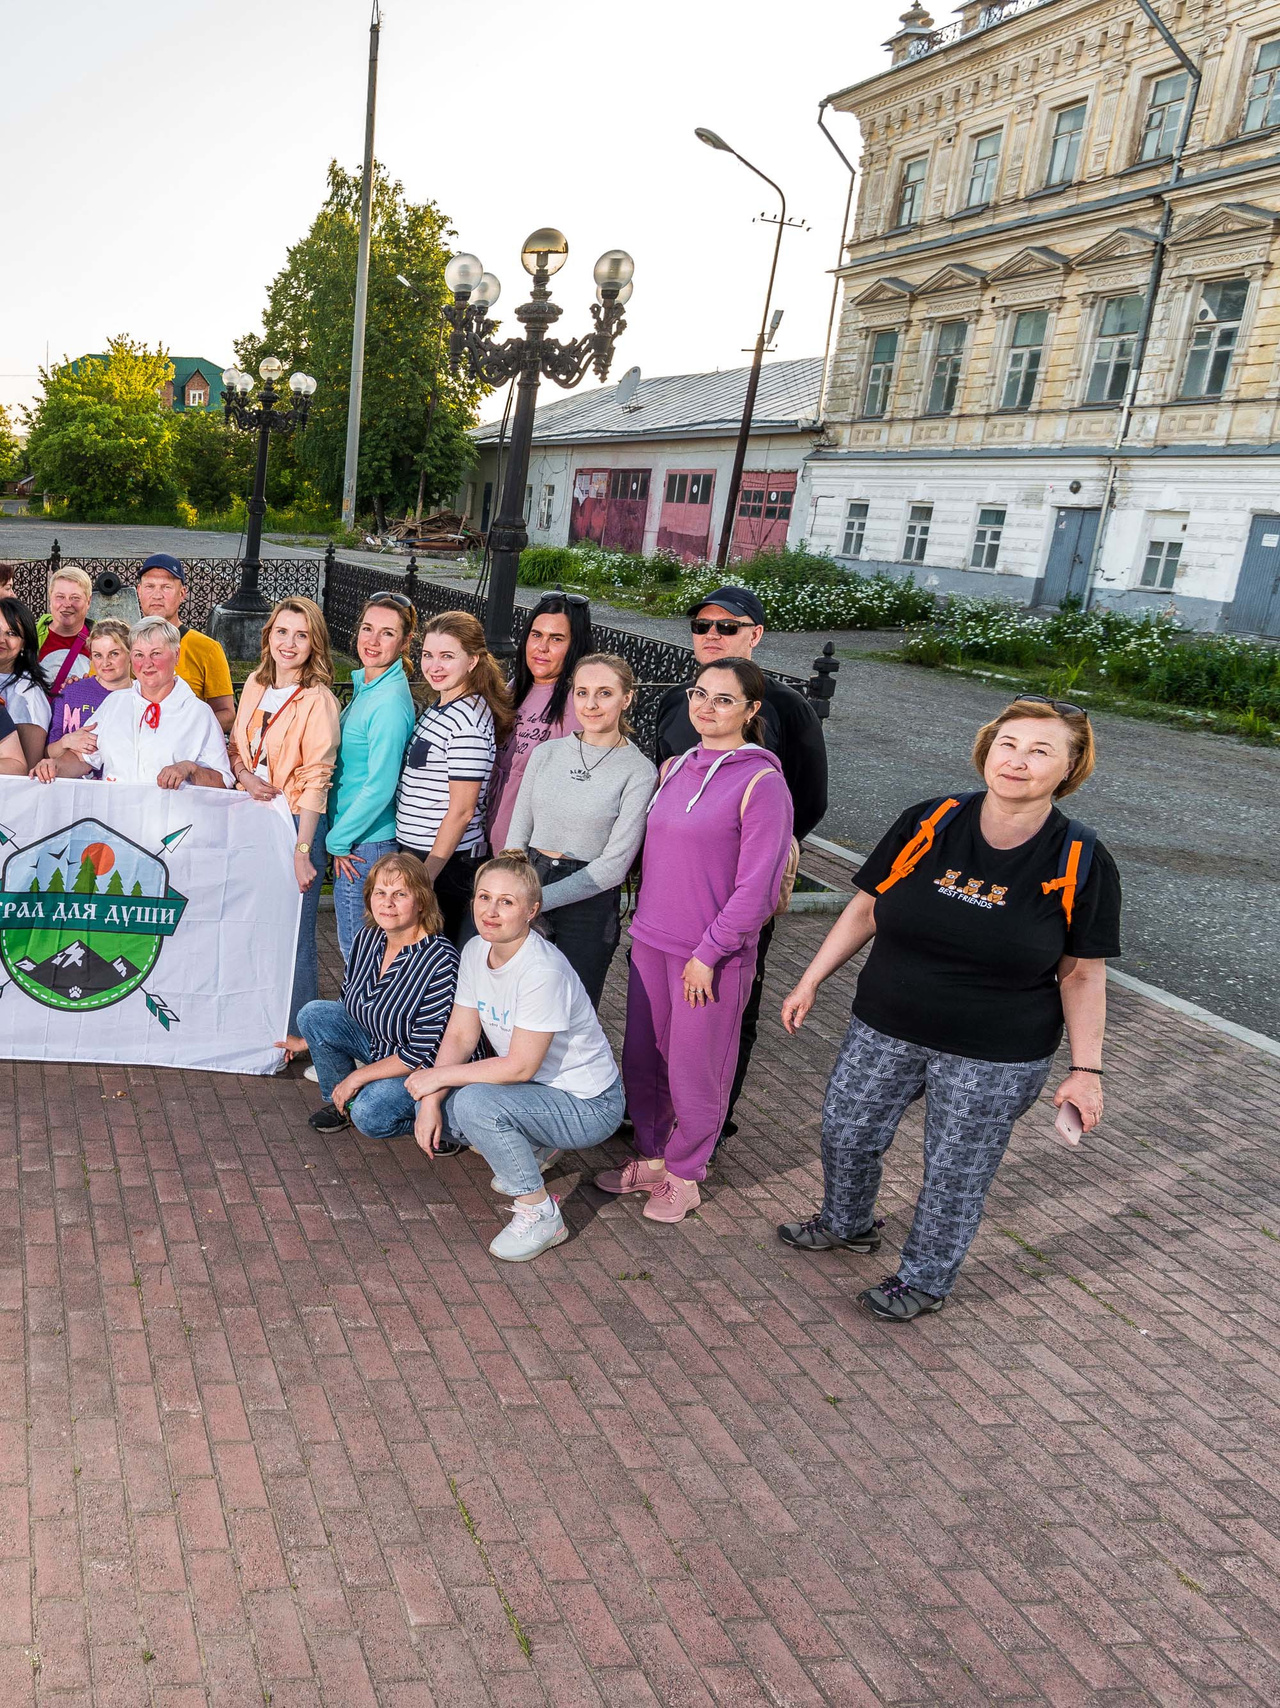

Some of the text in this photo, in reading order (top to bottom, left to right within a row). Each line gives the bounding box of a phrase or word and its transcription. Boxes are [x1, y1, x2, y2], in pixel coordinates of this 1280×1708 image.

[938, 886, 993, 909] BEST FRIENDS
[52, 902, 98, 922] ДЛЯ
[104, 904, 176, 927] ДУШИ
